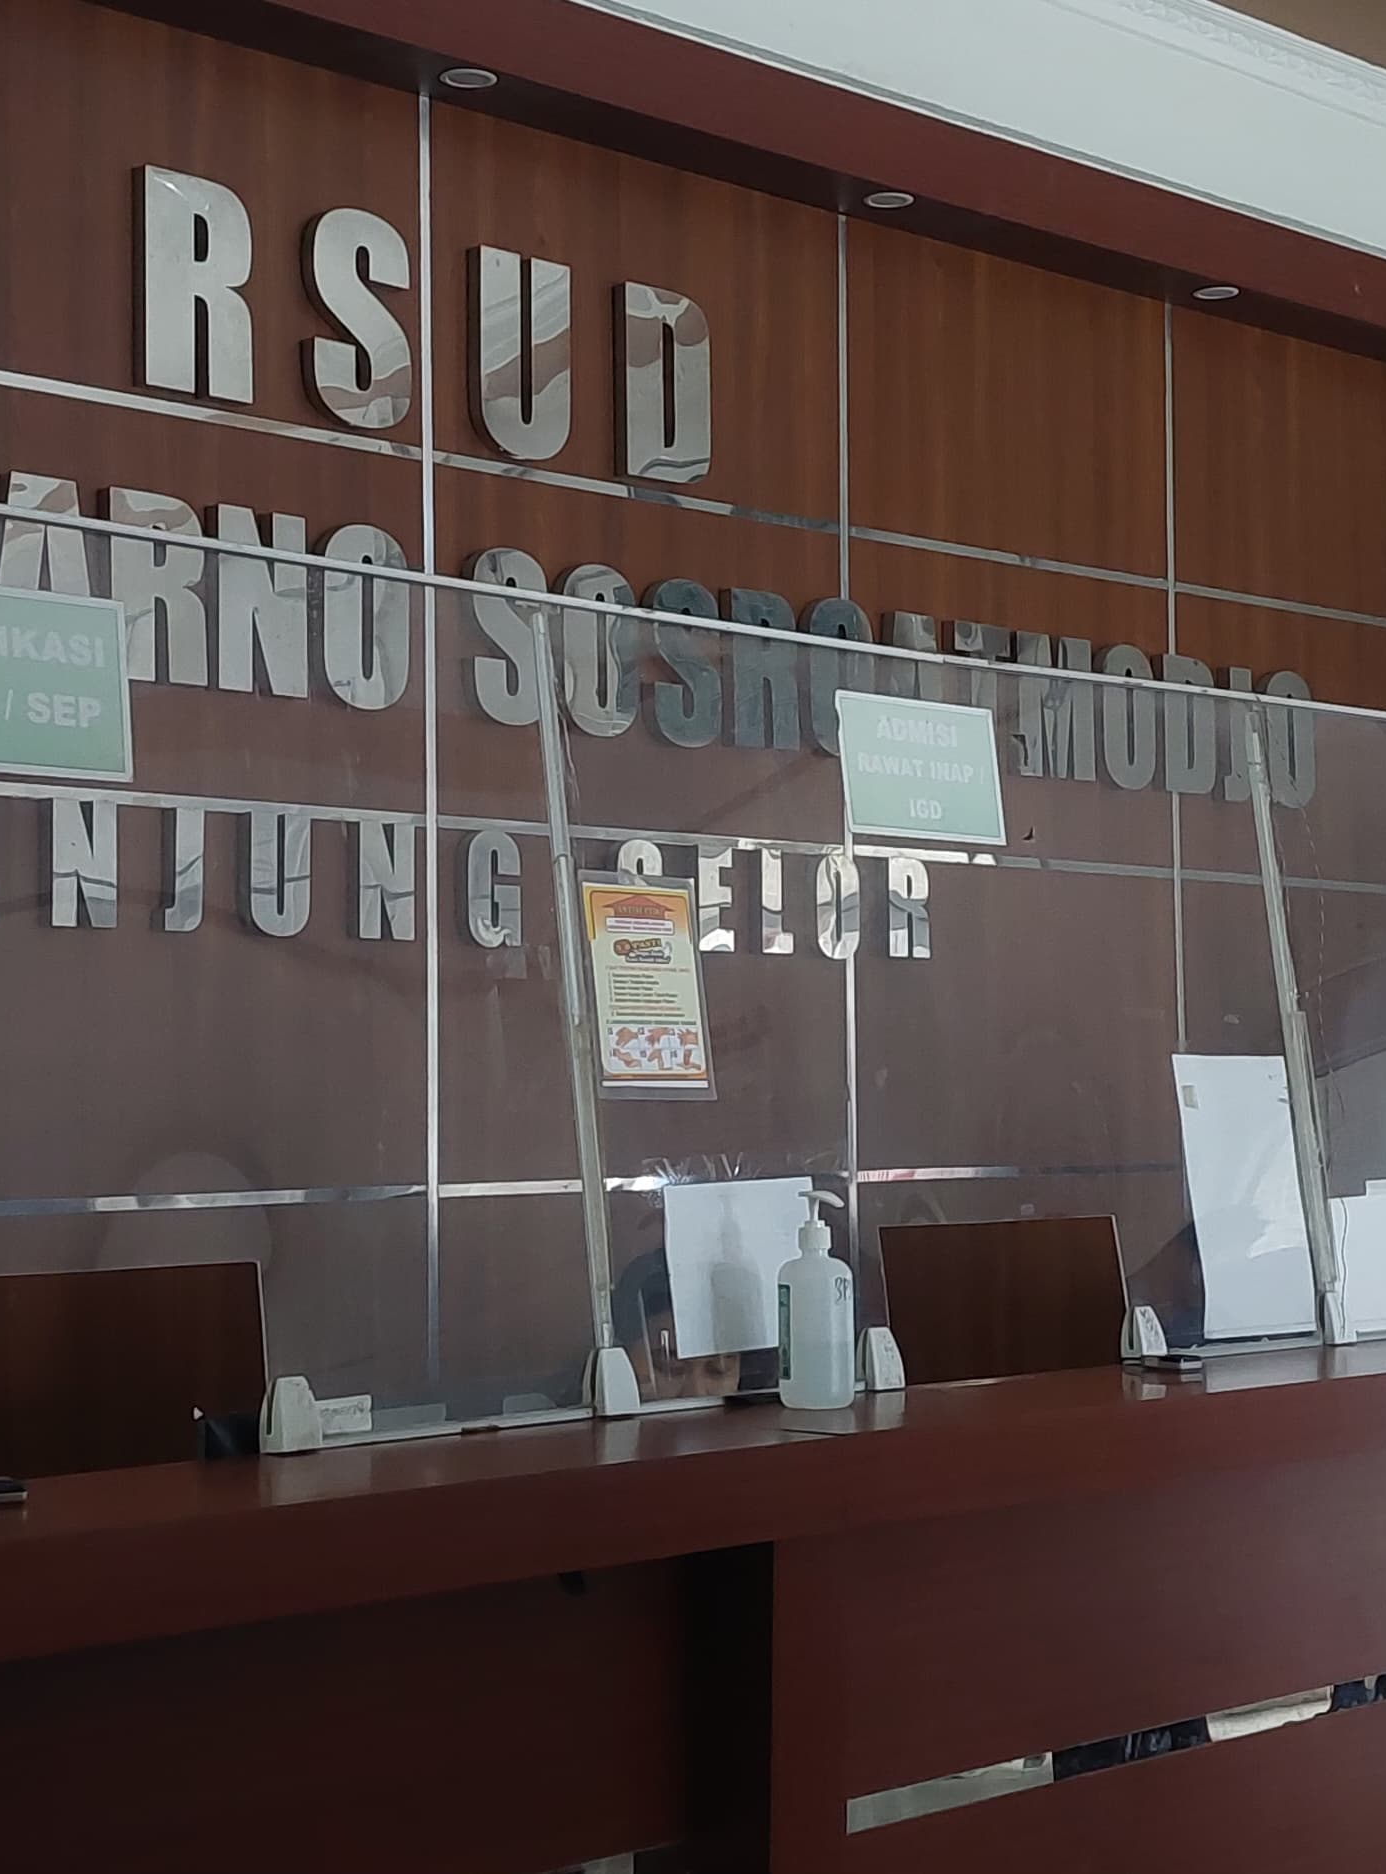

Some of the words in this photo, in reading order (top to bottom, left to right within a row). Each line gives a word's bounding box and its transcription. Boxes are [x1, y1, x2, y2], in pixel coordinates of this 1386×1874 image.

[134, 164, 711, 484] RSUD
[27, 692, 102, 728] SEP
[876, 715, 958, 747] ADMISI
[857, 752, 924, 778] RAWAT
[930, 761, 974, 784] INAP
[910, 798, 942, 820] IGD
